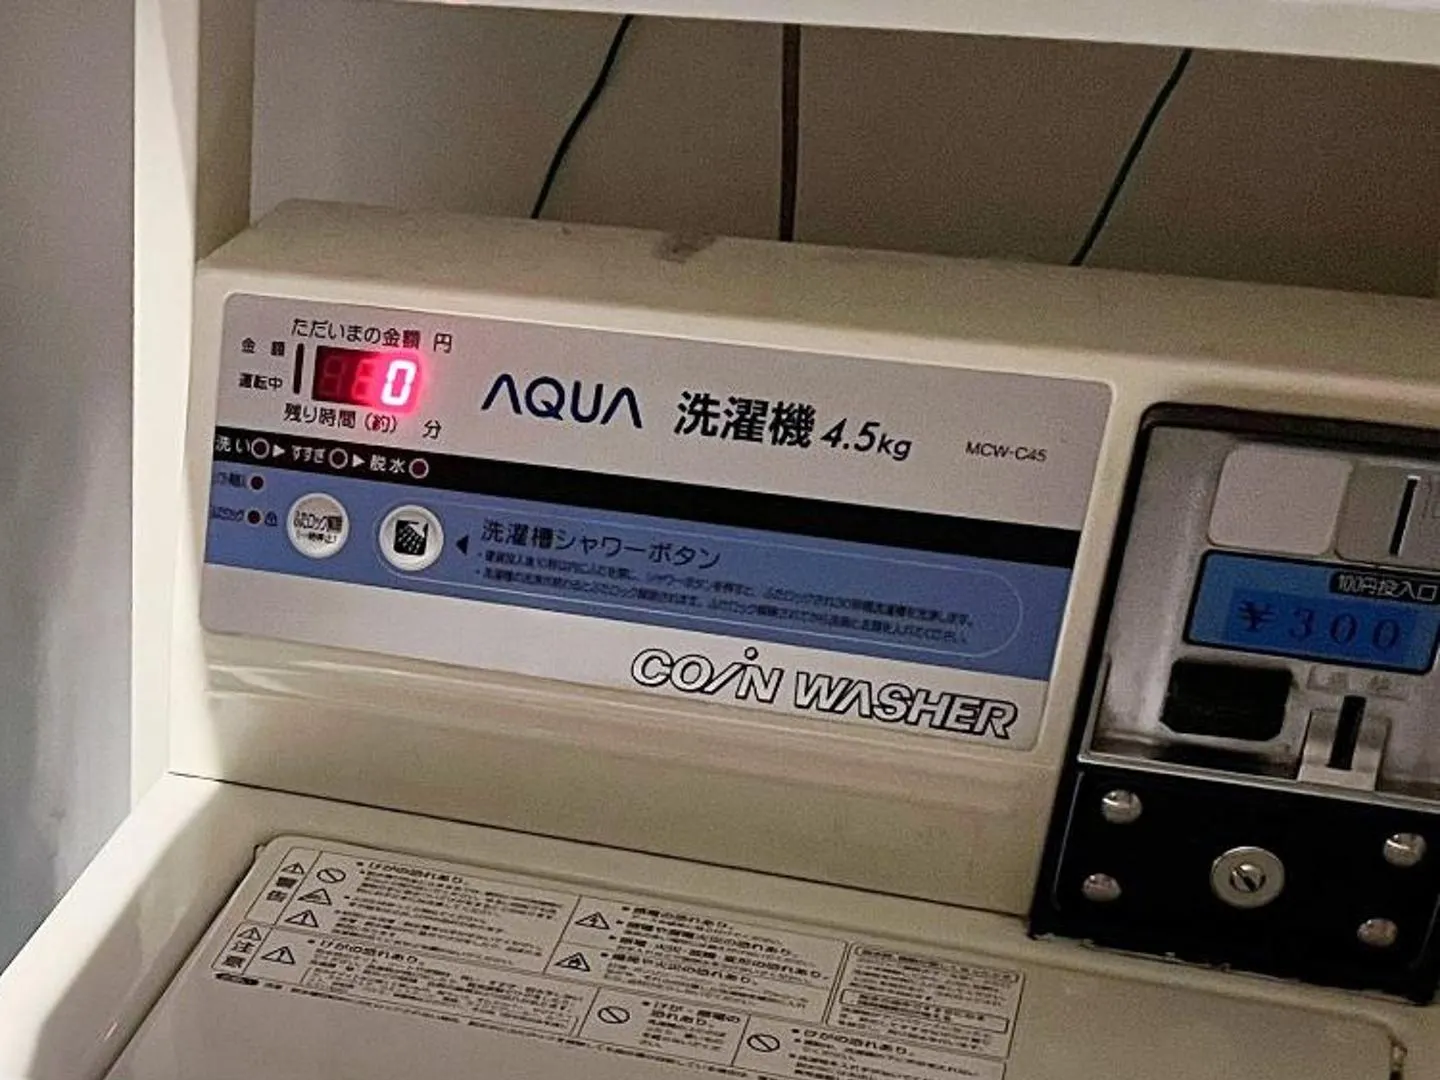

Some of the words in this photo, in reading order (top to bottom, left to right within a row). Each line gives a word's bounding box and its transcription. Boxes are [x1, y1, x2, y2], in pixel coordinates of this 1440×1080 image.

[291, 318, 421, 350] ただいまの金額
[433, 332, 453, 354] 円
[238, 371, 284, 391] 運転中
[380, 359, 416, 406] 0
[422, 419, 442, 440] 分
[481, 373, 644, 430] AQUA
[672, 390, 817, 450] 洗濯機
[820, 417, 914, 462] 4.5kg
[964, 440, 1048, 463] MCW-C45
[291, 444, 325, 464] すすぎ
[369, 454, 407, 474] 脱水
[480, 518, 721, 569] 洗濯槽シャワーボタン
[1337, 573, 1439, 602] 100円投入口
[630, 646, 786, 704] COIN
[794, 670, 1018, 740] WASHER
